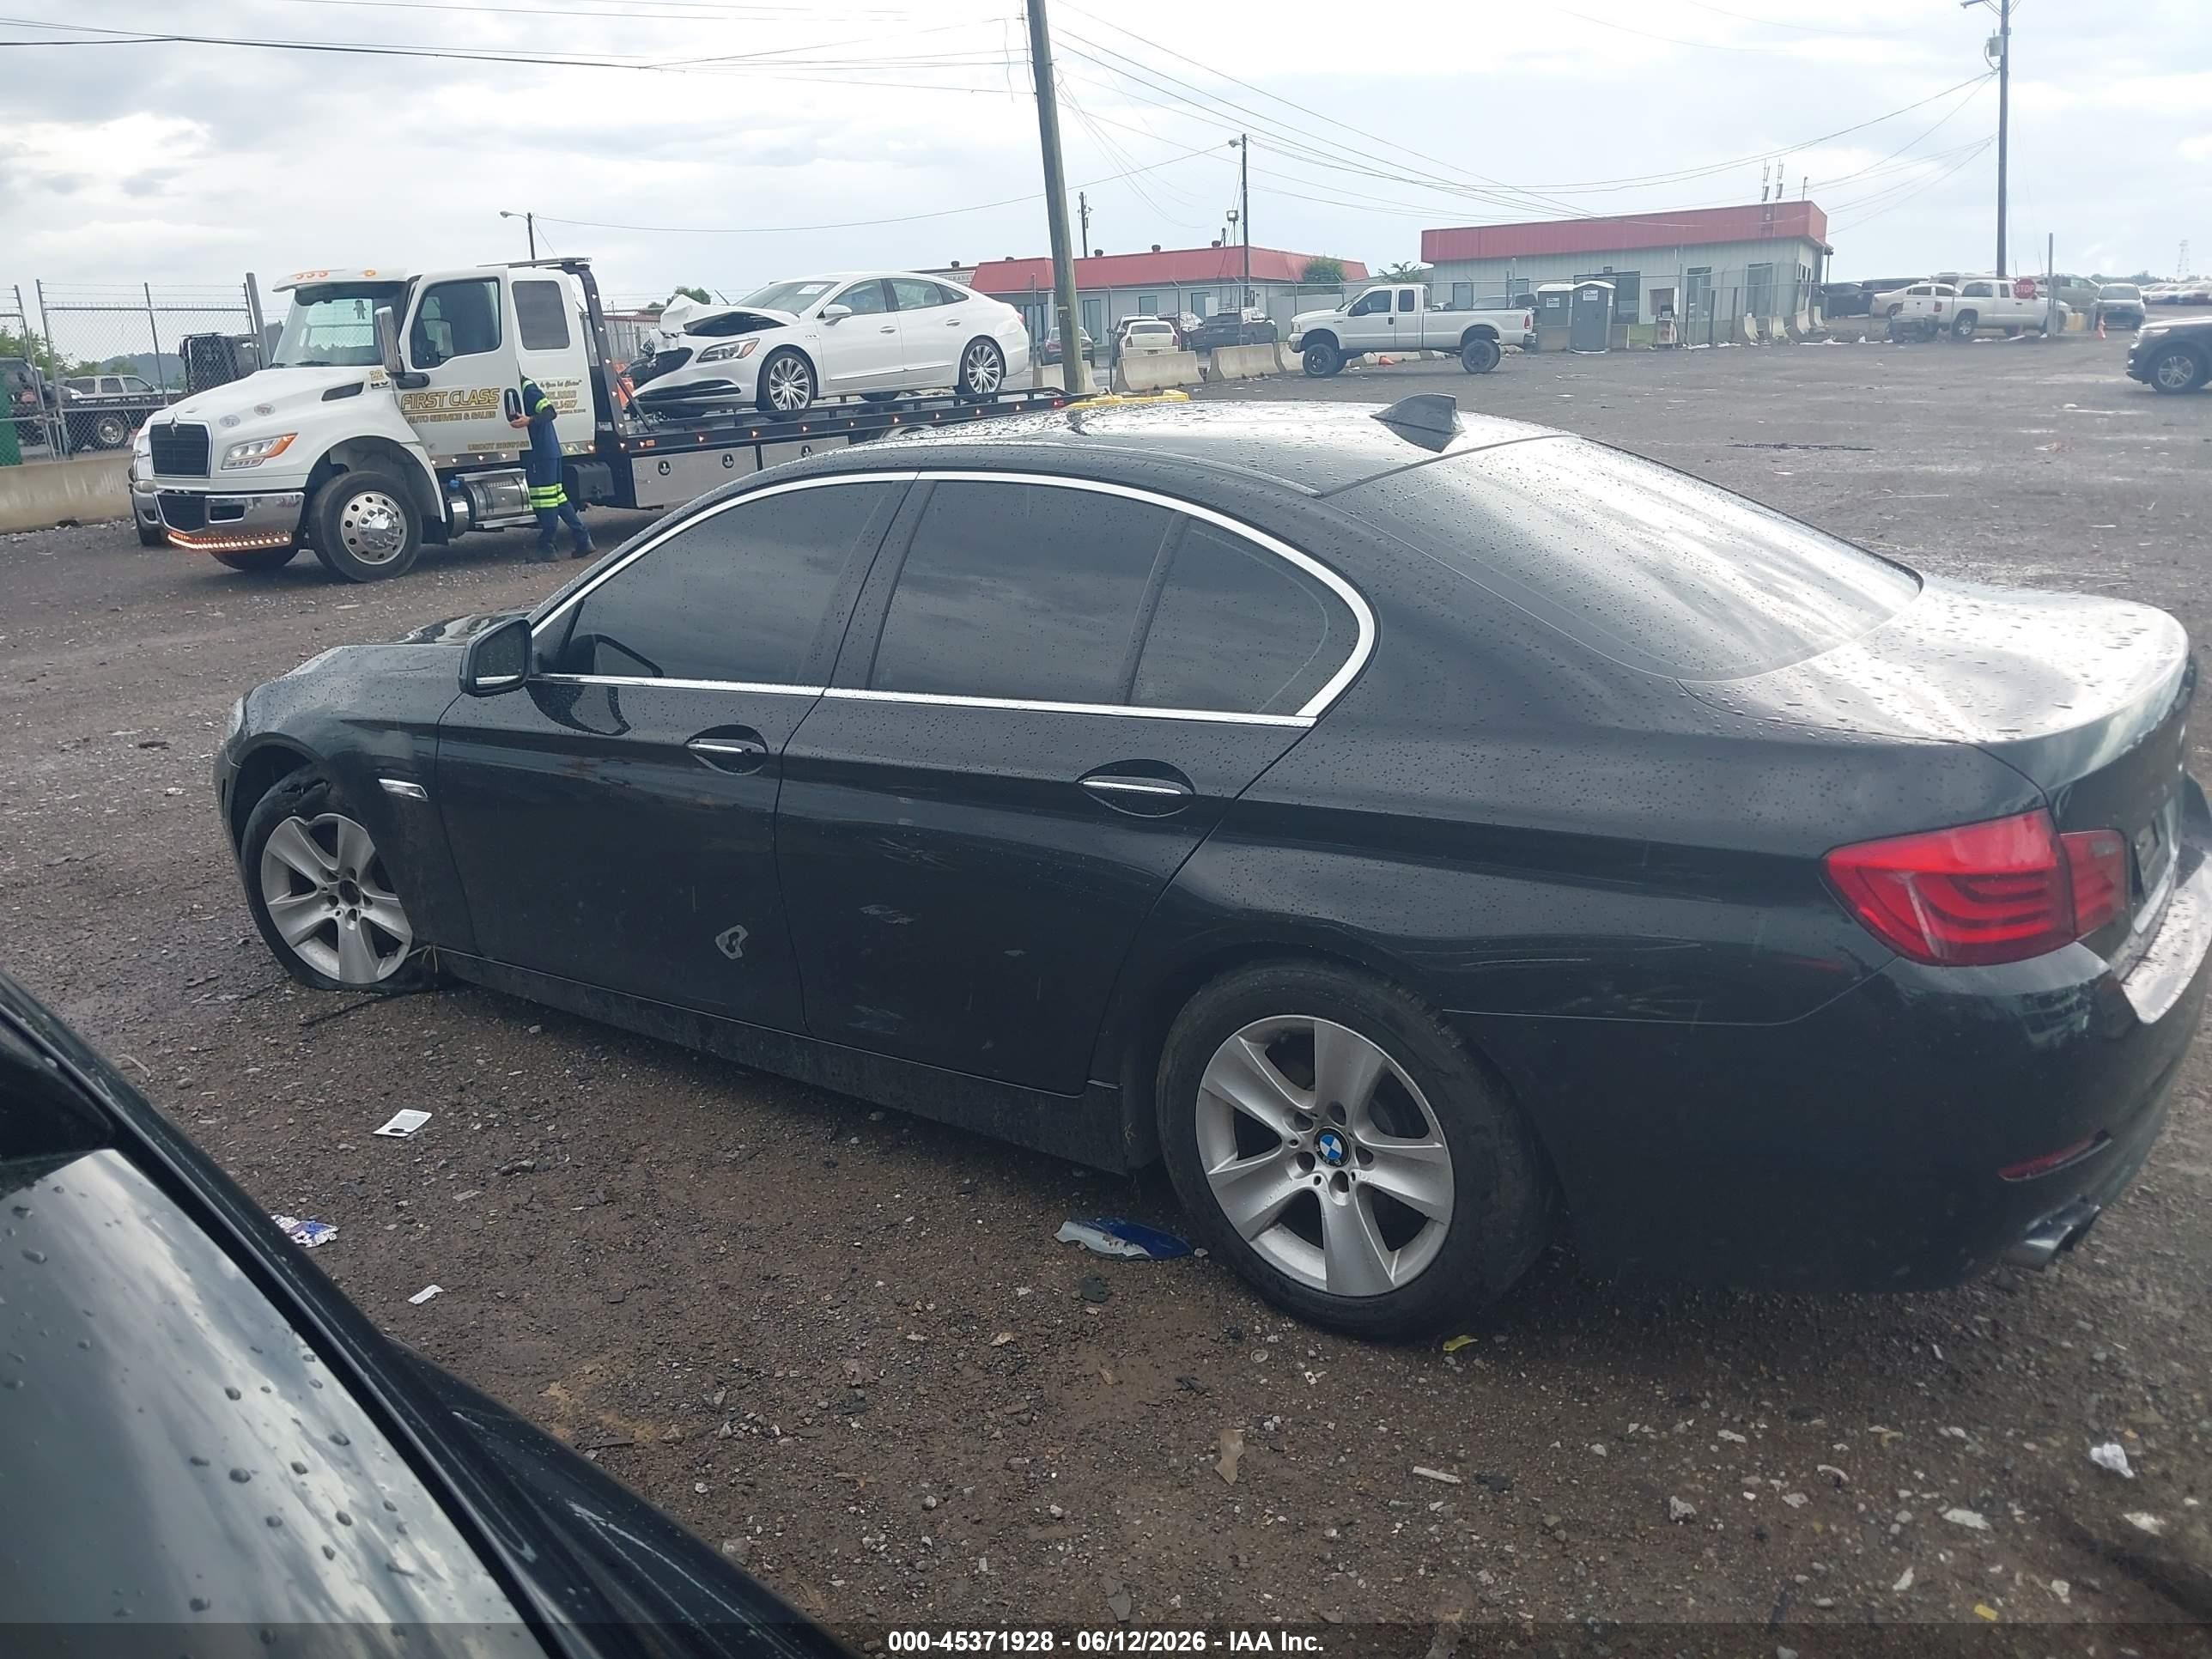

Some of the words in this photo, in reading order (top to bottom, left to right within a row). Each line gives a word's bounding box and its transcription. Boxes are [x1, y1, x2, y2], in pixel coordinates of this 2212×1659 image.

[2014, 284, 2035, 294] STOP
[400, 392, 448, 410] FIRST
[449, 387, 501, 407] CLASS
[407, 415, 429, 424] AUTO
[429, 412, 463, 423] SERVICE
[463, 412, 471, 421] &
[471, 410, 497, 421] SALES
